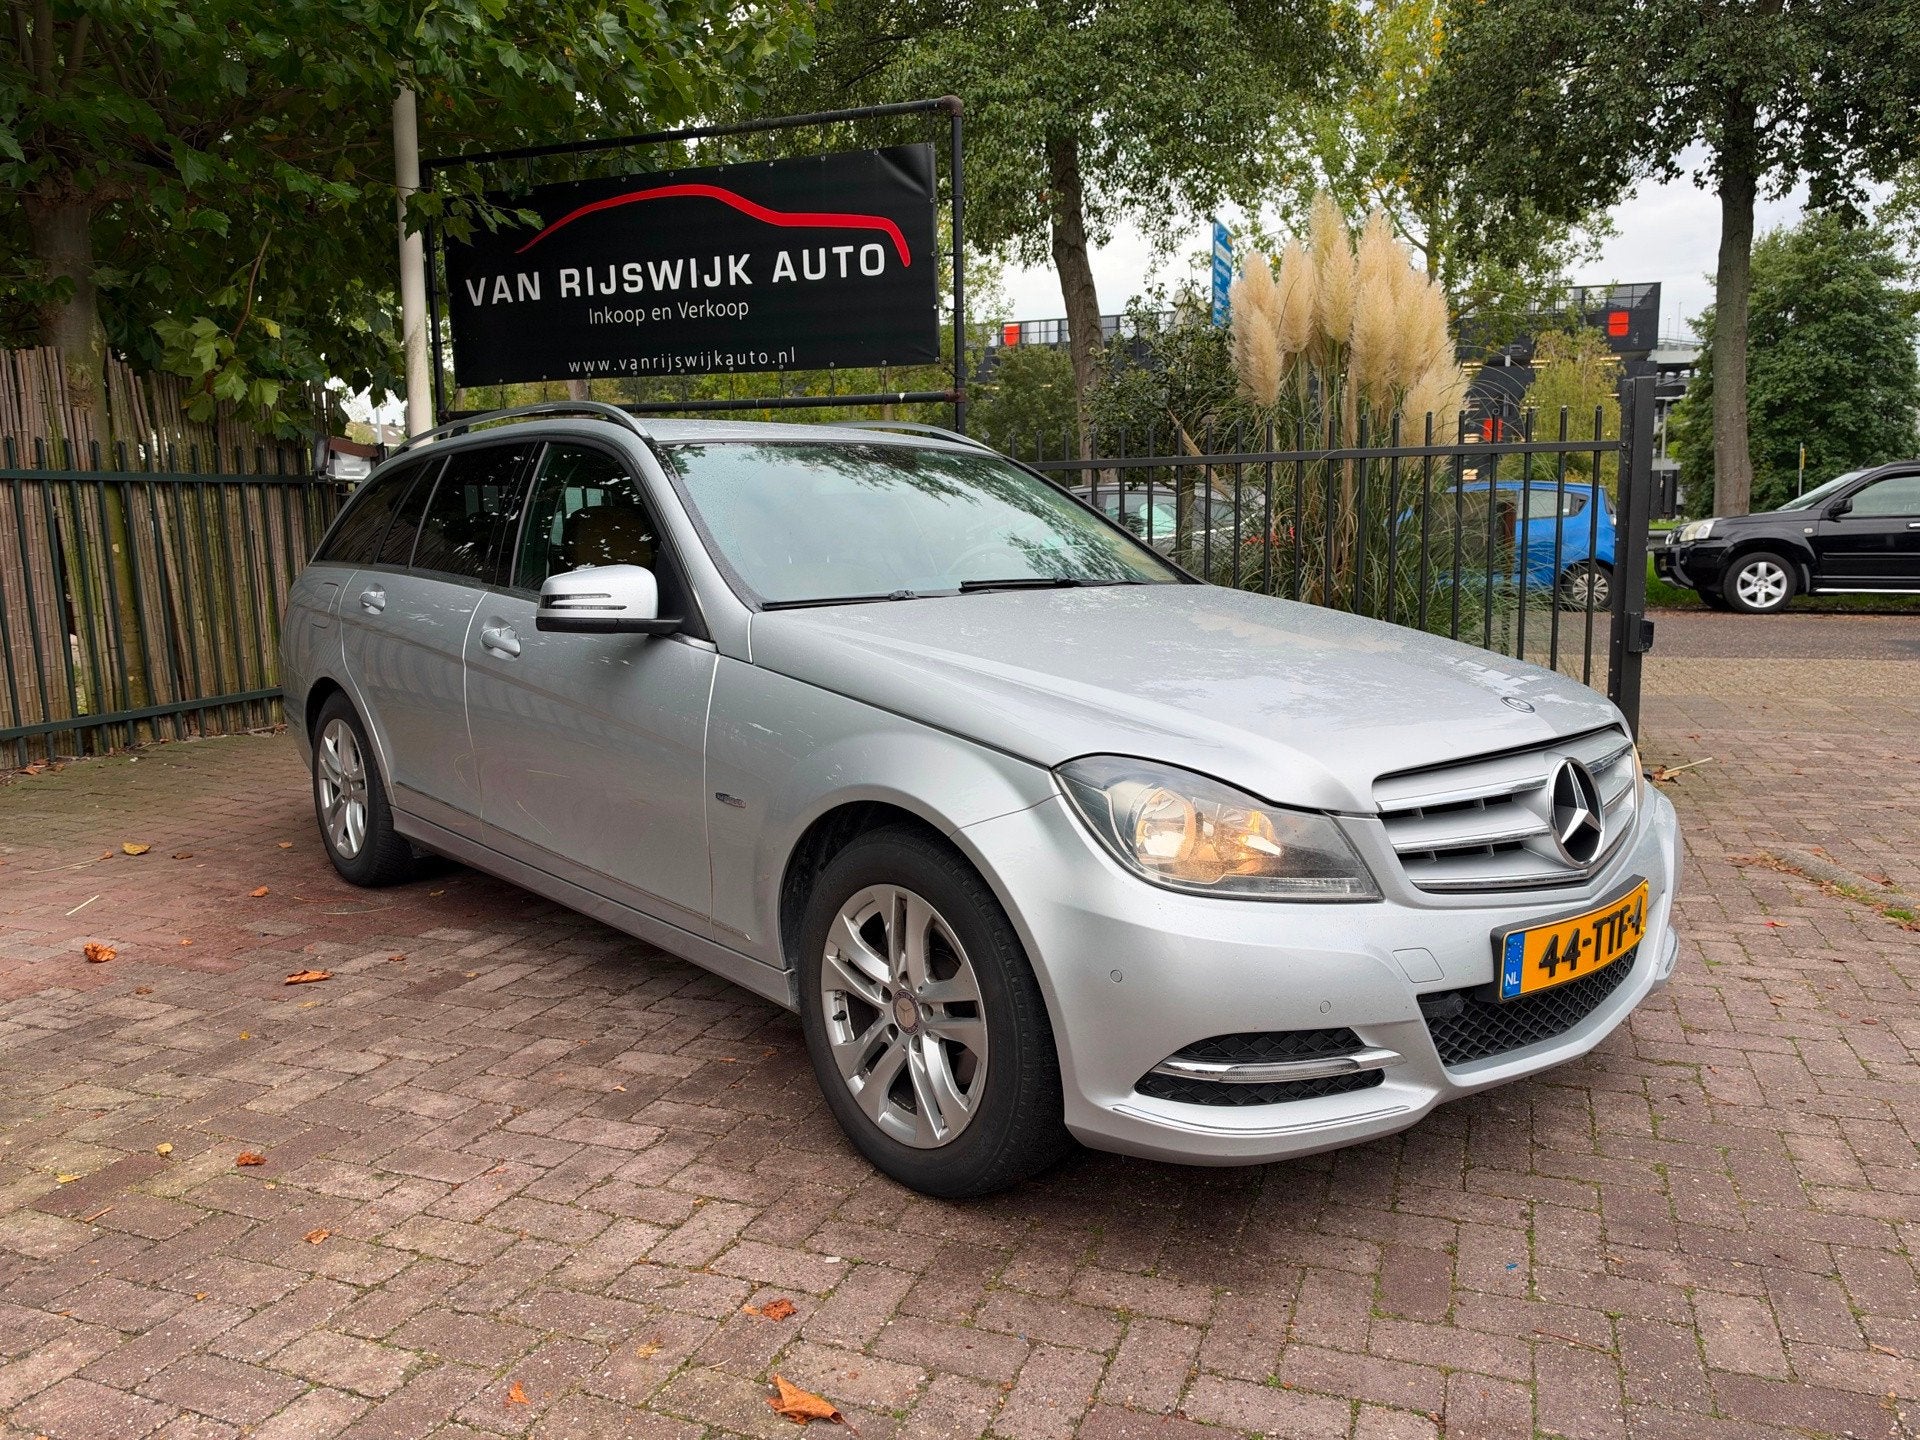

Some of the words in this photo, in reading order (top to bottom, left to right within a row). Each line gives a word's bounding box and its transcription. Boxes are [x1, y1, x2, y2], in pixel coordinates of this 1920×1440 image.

[465, 271, 542, 307] VAN
[559, 253, 753, 298] RIJSWIJK
[771, 242, 886, 284] AUTO
[588, 305, 647, 328] Inkoop
[651, 306, 673, 321] en
[677, 298, 750, 321] Verkoop
[567, 345, 796, 374] www.vanrijswijkauto.nl
[1538, 895, 1643, 978] 44-TTF-4
[1504, 971, 1520, 987] NL
